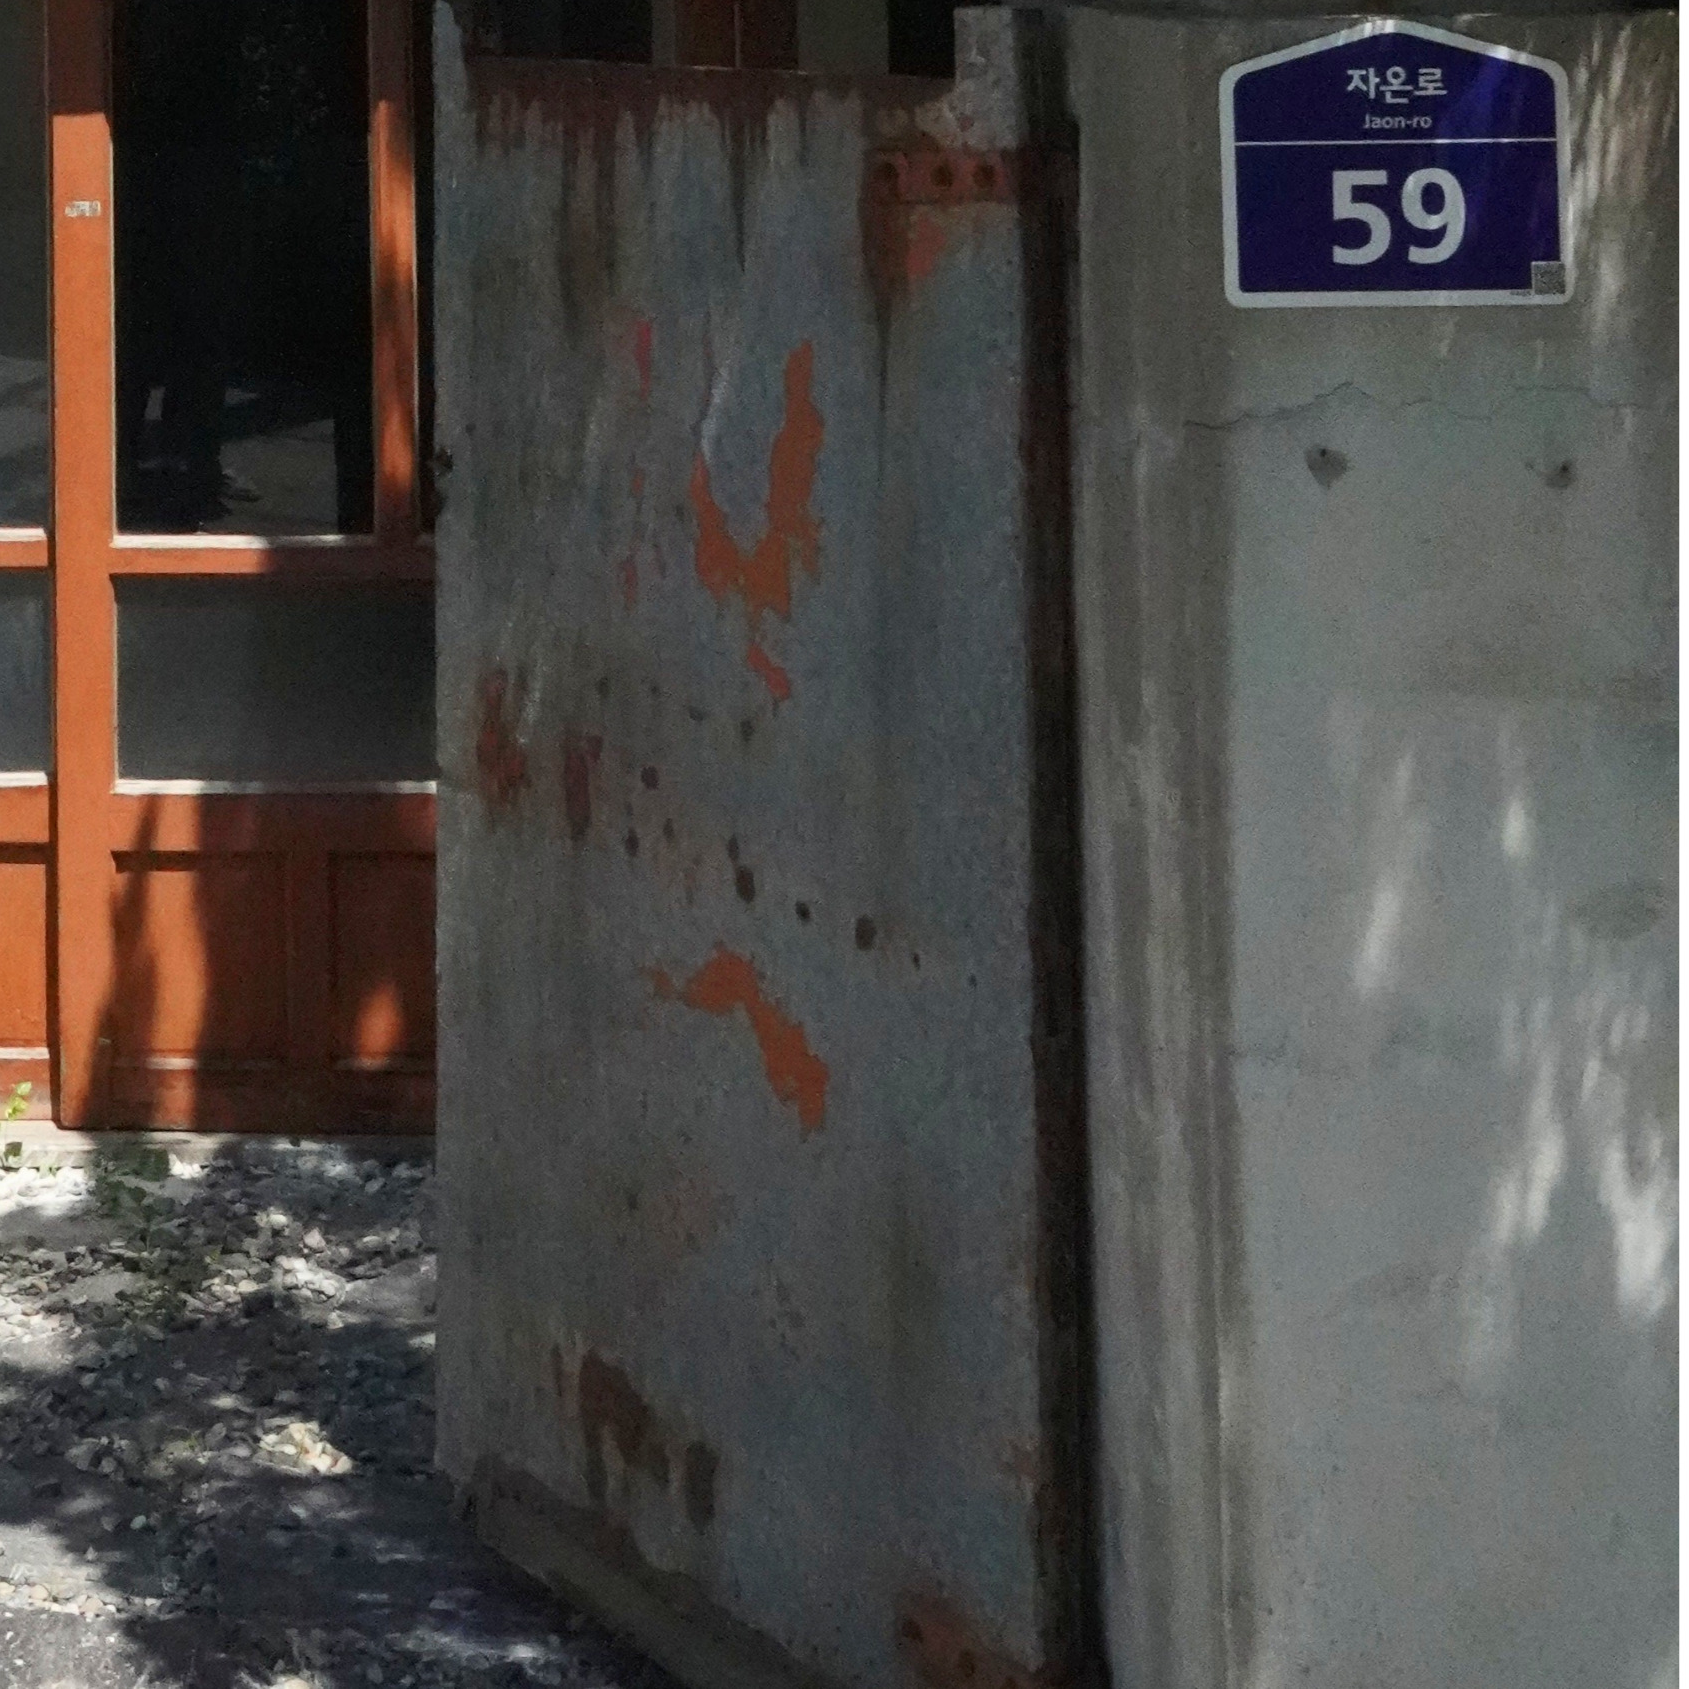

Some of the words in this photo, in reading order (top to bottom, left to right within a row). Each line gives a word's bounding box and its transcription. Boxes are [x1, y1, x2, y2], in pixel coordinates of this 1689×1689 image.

[1345, 67, 1448, 104] 자온로
[1362, 113, 1433, 129] Jaon-ro
[1331, 167, 1467, 266] 59
